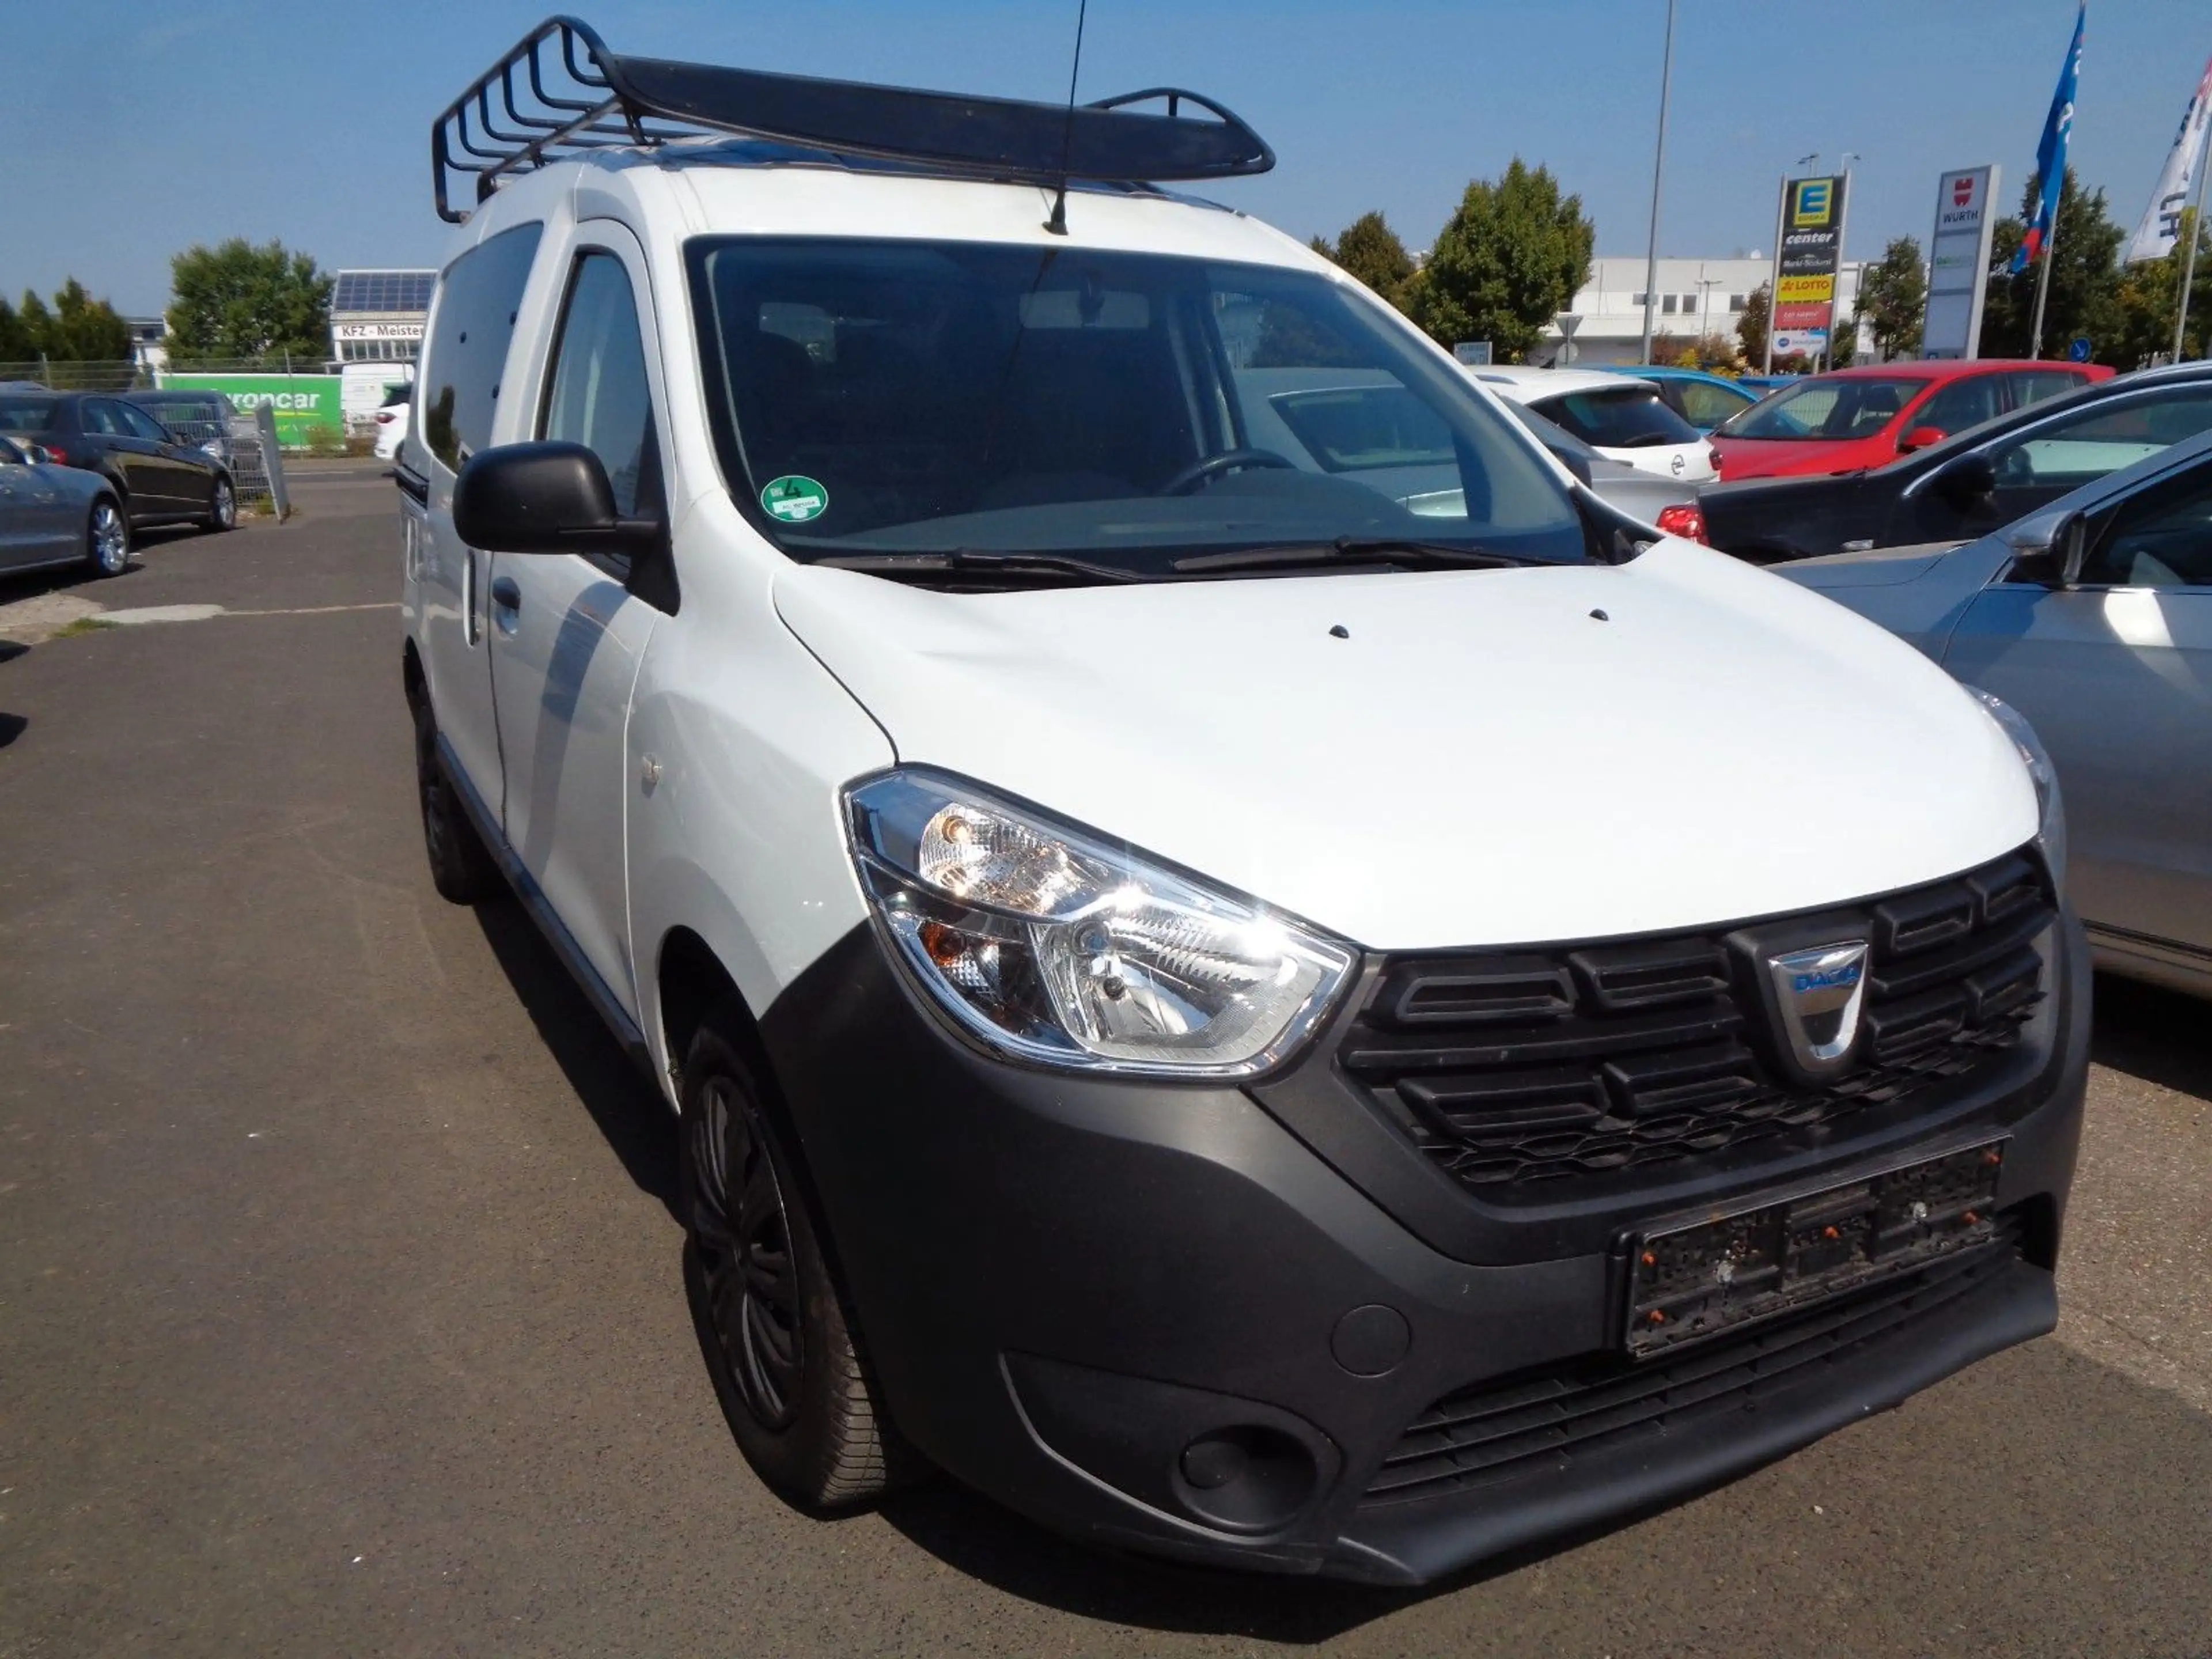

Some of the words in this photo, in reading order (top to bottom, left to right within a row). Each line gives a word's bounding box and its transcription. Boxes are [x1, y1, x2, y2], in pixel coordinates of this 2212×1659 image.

[1786, 232, 1834, 244] center
[1796, 280, 1830, 290] LOTTO
[342, 325, 366, 336] KFZ
